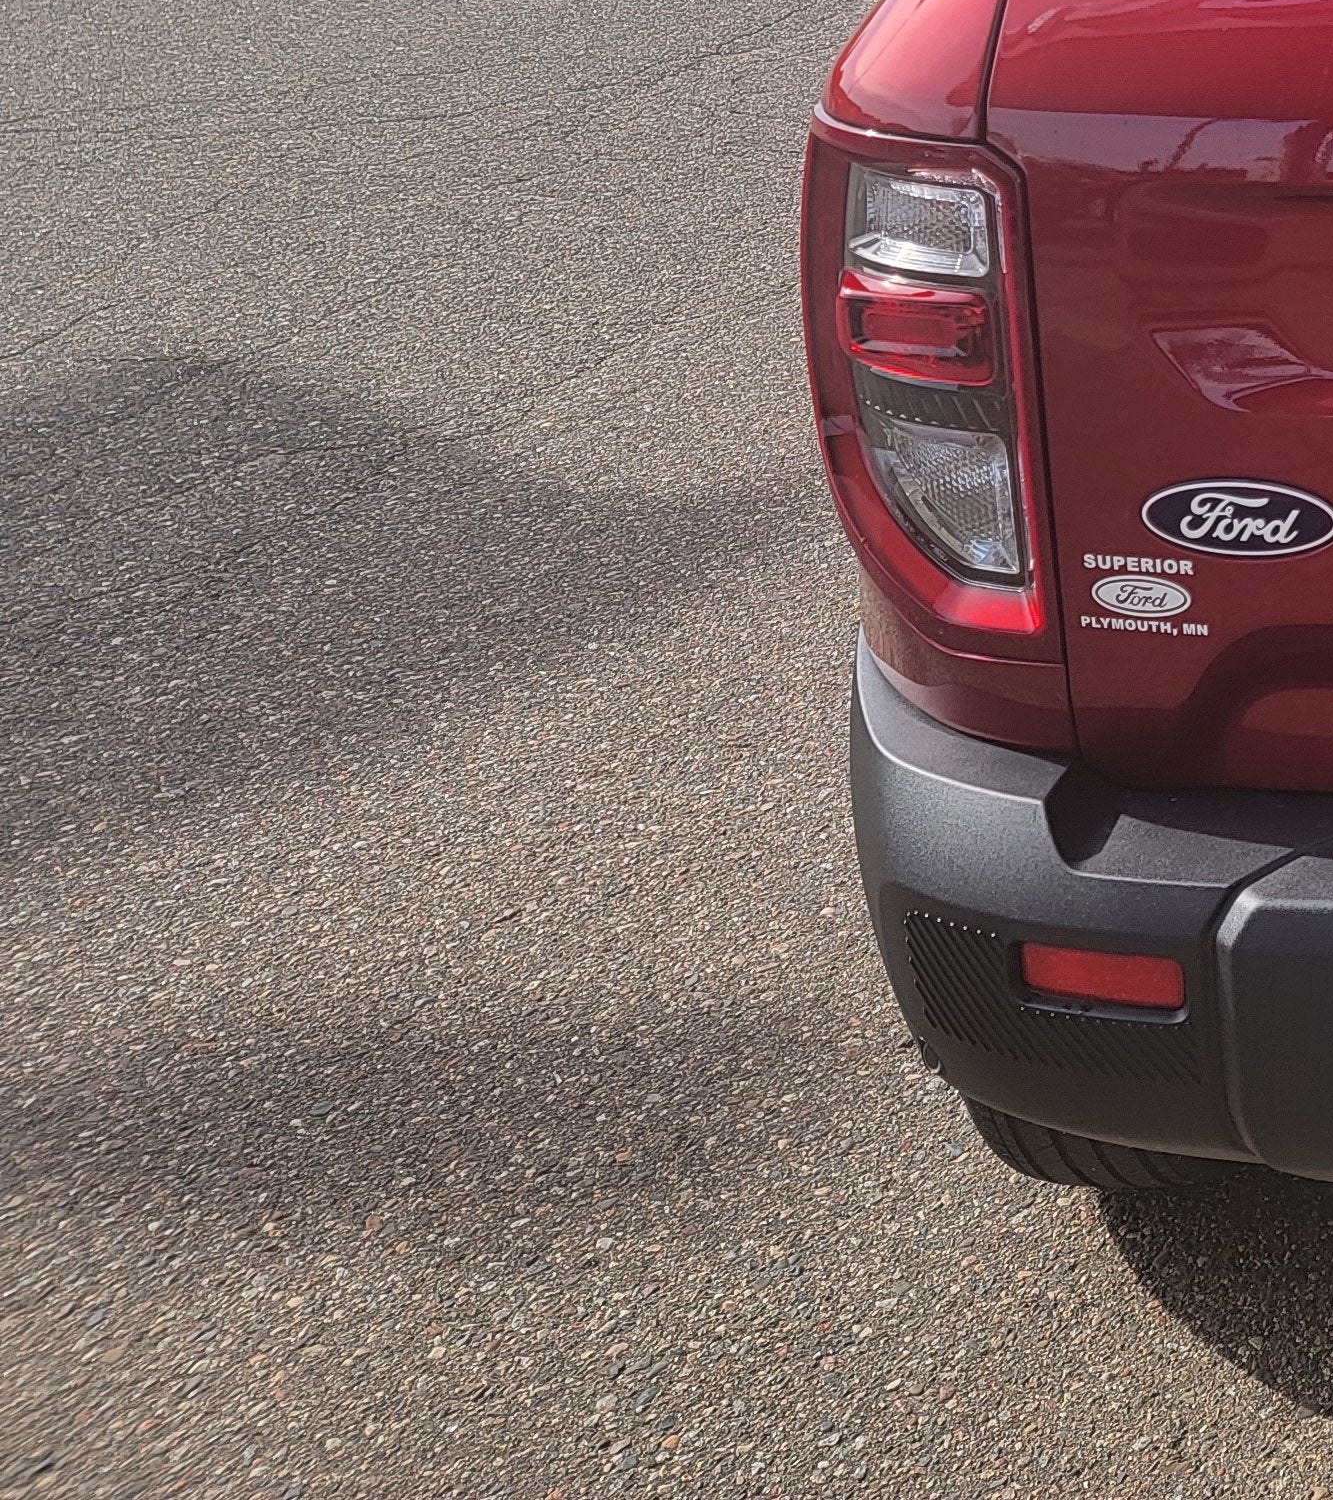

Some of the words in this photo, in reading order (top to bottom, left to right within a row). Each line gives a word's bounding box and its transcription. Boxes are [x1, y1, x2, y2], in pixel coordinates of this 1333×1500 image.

[1179, 492, 1301, 544] Ford
[1083, 554, 1194, 576] SUPERIOR
[1115, 584, 1169, 609] Ford
[1080, 616, 1178, 637] PLYMOUTH,
[1182, 623, 1209, 636] MN
